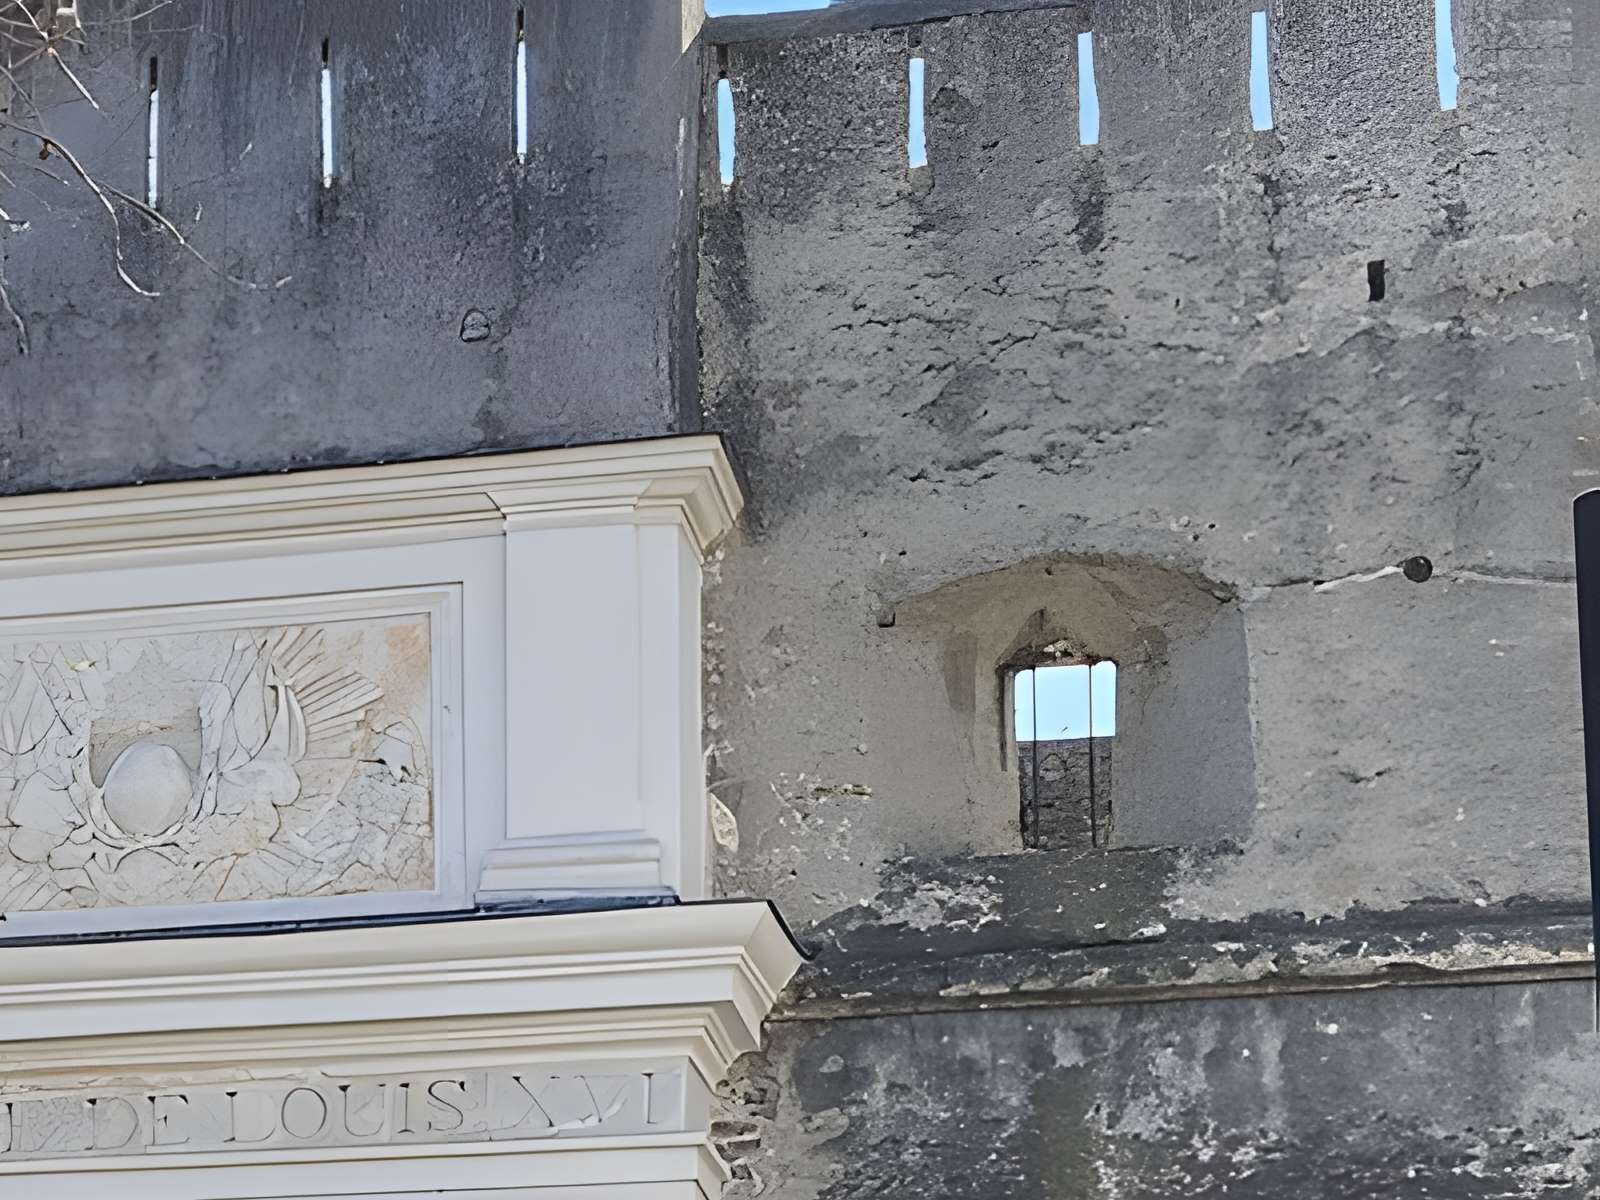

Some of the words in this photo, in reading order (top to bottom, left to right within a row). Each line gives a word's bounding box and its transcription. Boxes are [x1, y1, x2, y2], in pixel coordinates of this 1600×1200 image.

[84, 1093, 190, 1152] DE
[223, 1078, 466, 1144] LOUIS
[510, 1071, 658, 1129] XVI
